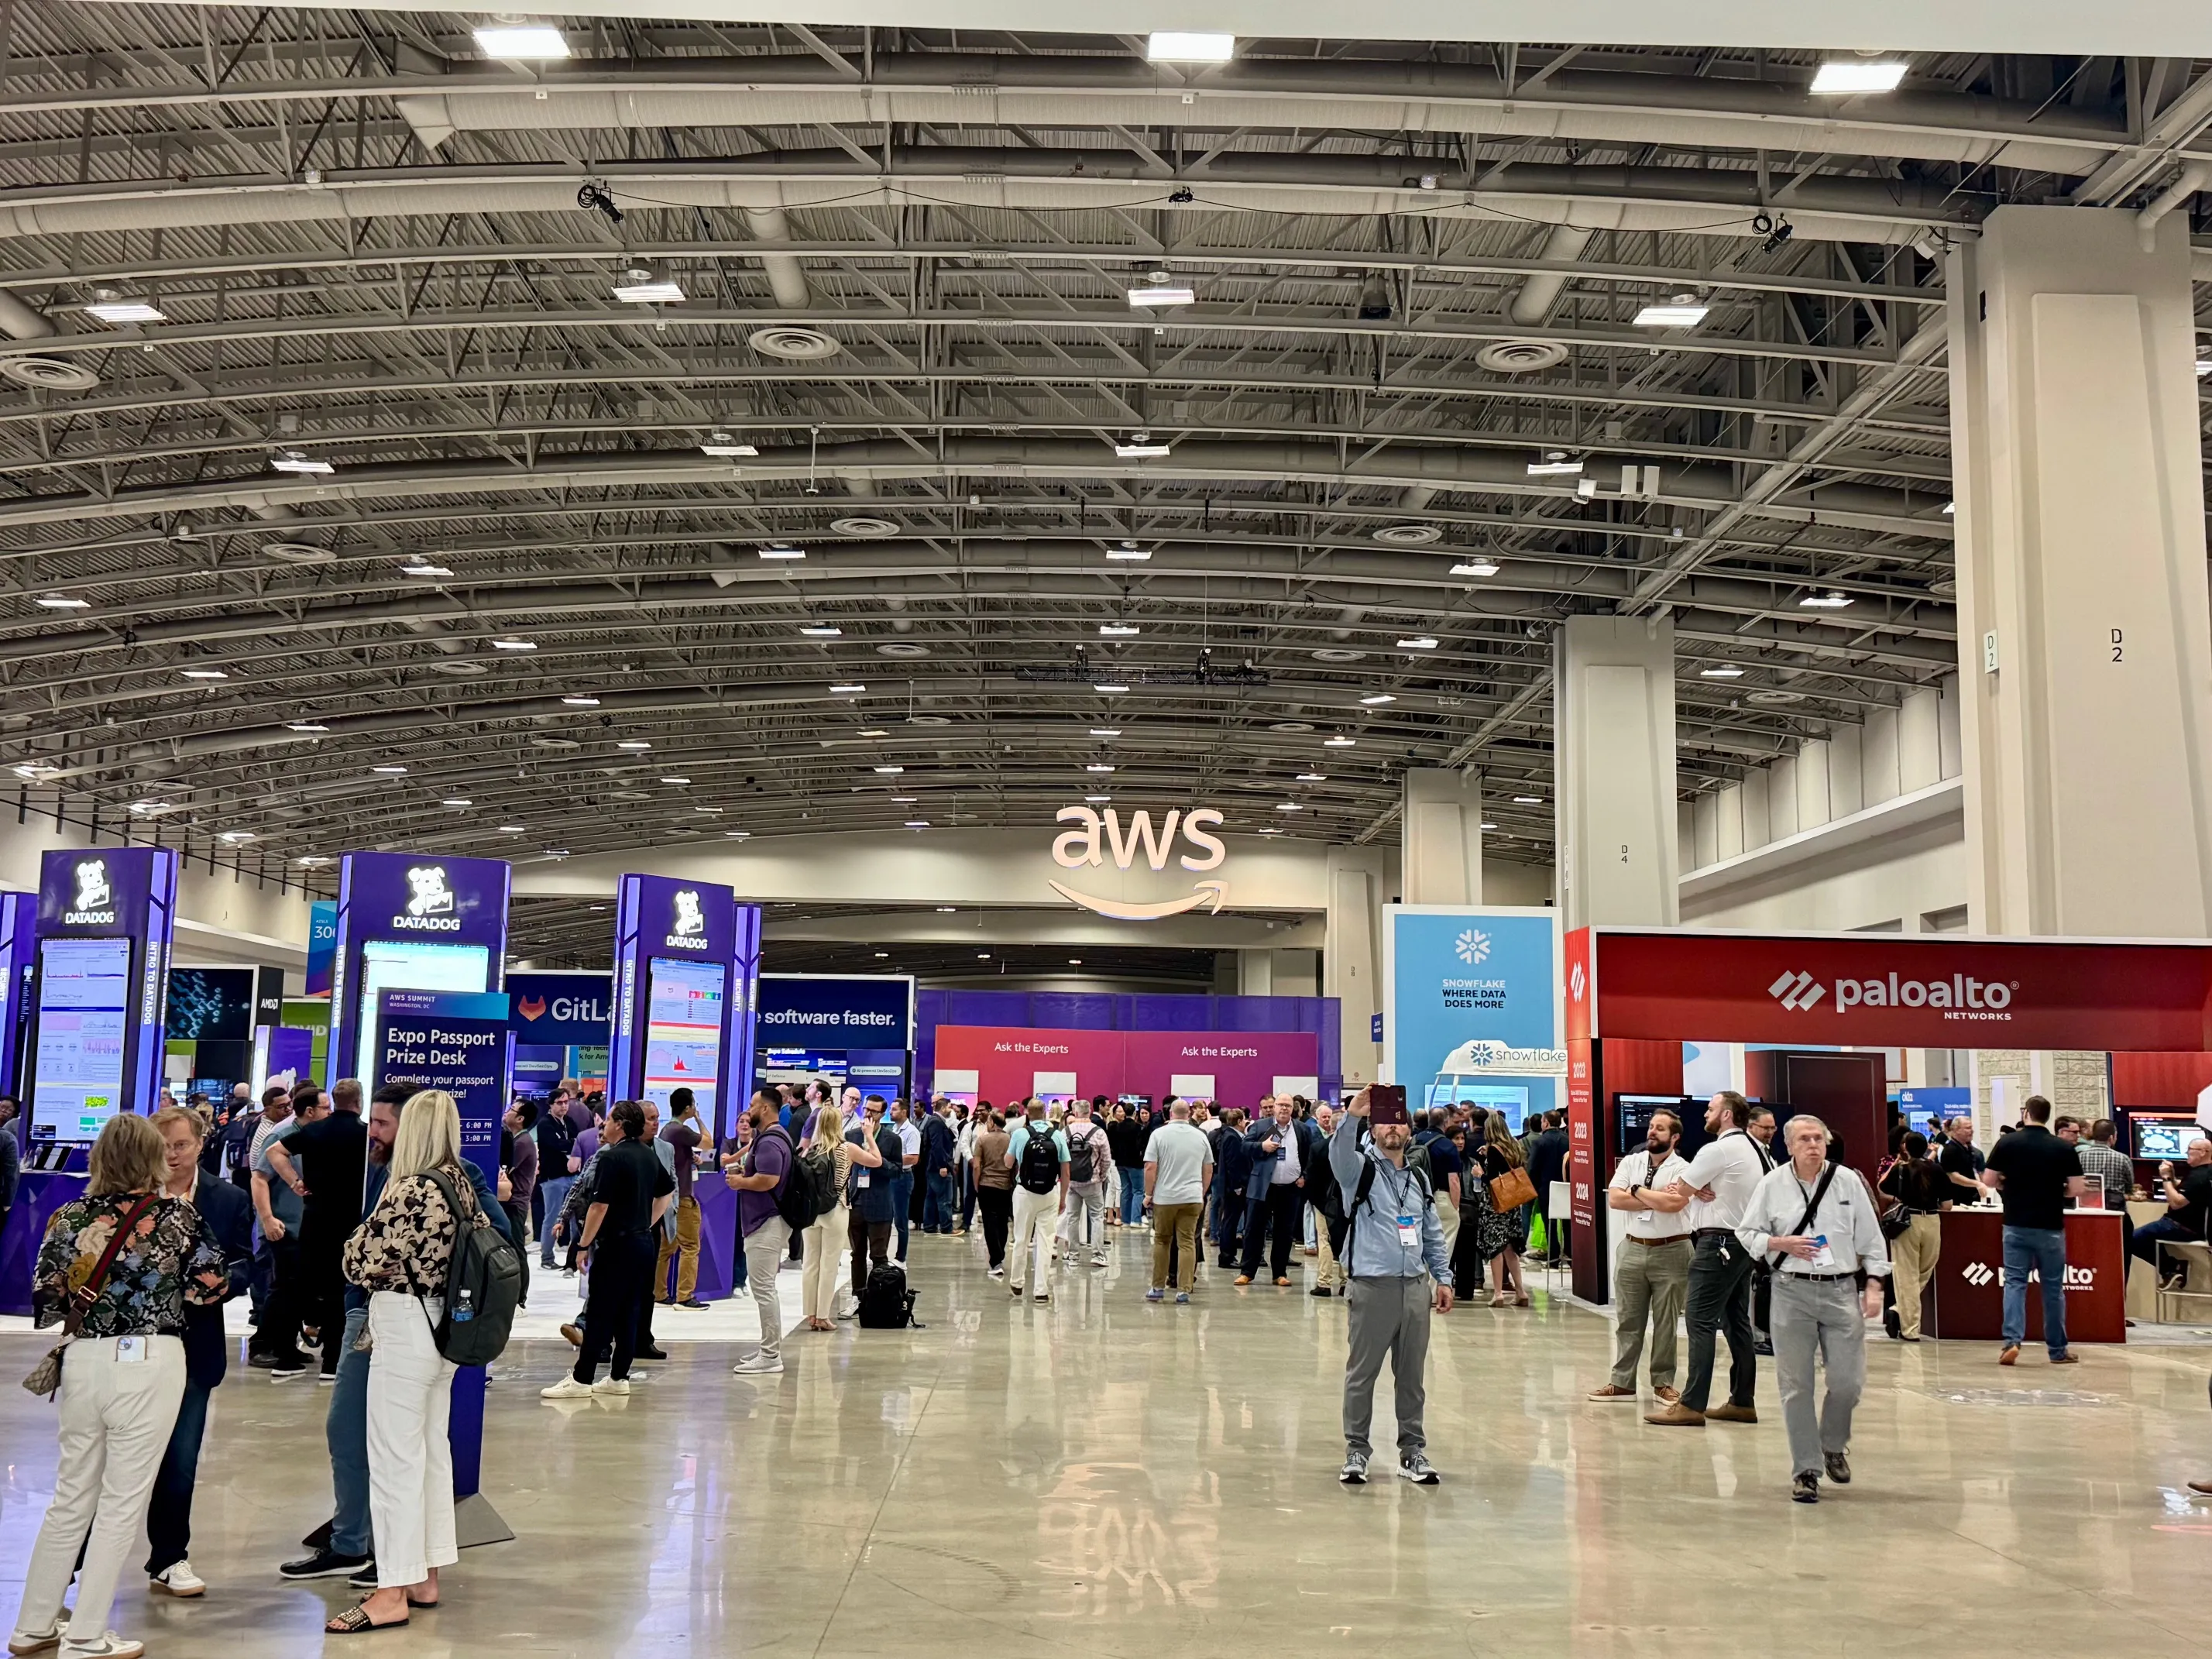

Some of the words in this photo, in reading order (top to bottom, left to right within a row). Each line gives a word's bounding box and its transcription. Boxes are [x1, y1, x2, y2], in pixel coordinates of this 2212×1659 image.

[1987, 635, 1994, 650] D
[2111, 628, 2123, 644] D
[1988, 653, 1994, 668] 2
[2111, 647, 2123, 663] 2
[1052, 806, 1226, 871] aws
[1621, 845, 1628, 854] D
[1621, 855, 1628, 864] 4
[65, 912, 115, 924] DATADOG
[393, 916, 461, 931] DATADOG
[666, 935, 708, 950] DATADOG
[148, 941, 158, 968] INTRO
[147, 970, 156, 982] TO
[624, 959, 633, 984] INTRO
[1442, 978, 1506, 988] SNOWFLAKE
[623, 985, 632, 997] TO
[1442, 989, 1479, 998] WHERE
[1481, 990, 1506, 998] DATA
[1836, 972, 2011, 1013] paloalto
[143, 984, 155, 1025] DATADOG
[1444, 999, 1472, 1008] DOES
[1475, 1000, 1504, 1008] MORE
[622, 998, 631, 1036] DATADOG
[764, 1008, 840, 1025] software
[843, 1009, 895, 1025] faster.
[1944, 1012, 2011, 1021] NETWORKS
[388, 1028, 426, 1046] Expo
[431, 1029, 496, 1049] Passport
[994, 1042, 1012, 1052] Ask
[1015, 1042, 1031, 1053] the
[1033, 1043, 1069, 1055] Experts
[1181, 1046, 1199, 1056] Ask
[1201, 1046, 1218, 1056] the
[1221, 1046, 1258, 1058] Experts
[386, 1049, 425, 1064] Prize
[430, 1049, 467, 1065] Desk
[385, 1073, 431, 1084] Complete
[432, 1076, 454, 1087] your
[455, 1075, 494, 1087] passport
[1575, 1121, 1587, 1139] 2023
[1575, 1182, 1589, 1200] 2024
